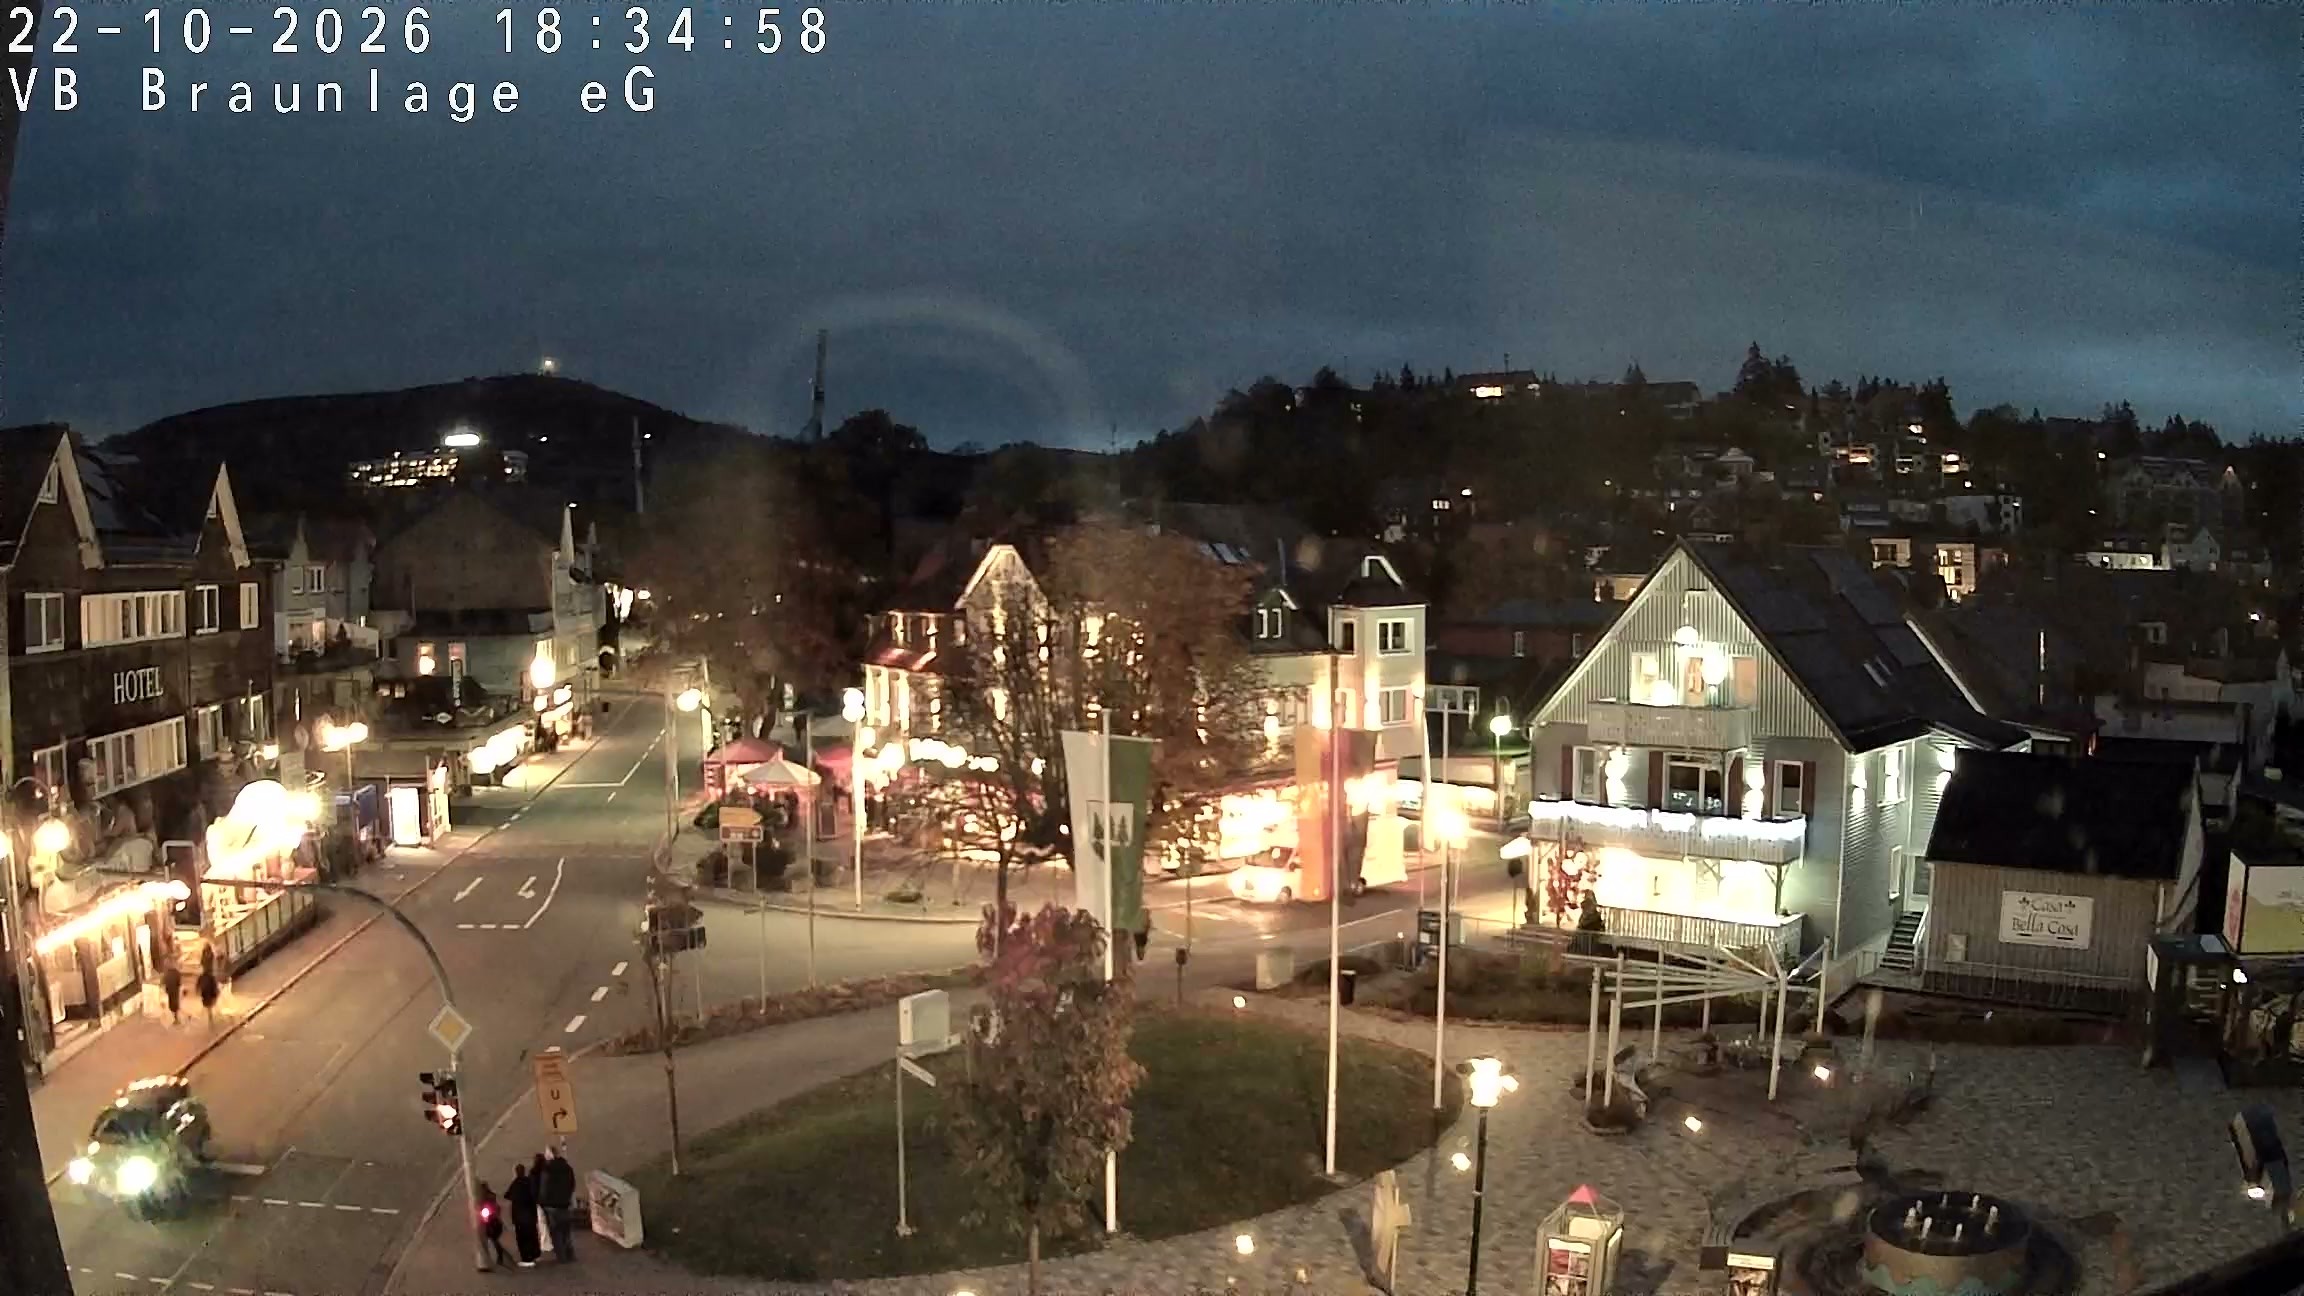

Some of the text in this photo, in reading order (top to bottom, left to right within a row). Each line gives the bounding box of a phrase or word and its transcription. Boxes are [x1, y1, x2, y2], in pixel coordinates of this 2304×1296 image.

[113, 666, 164, 705] HOTEL
[2012, 912, 2044, 933] Bella
[550, 1089, 561, 1101] U
